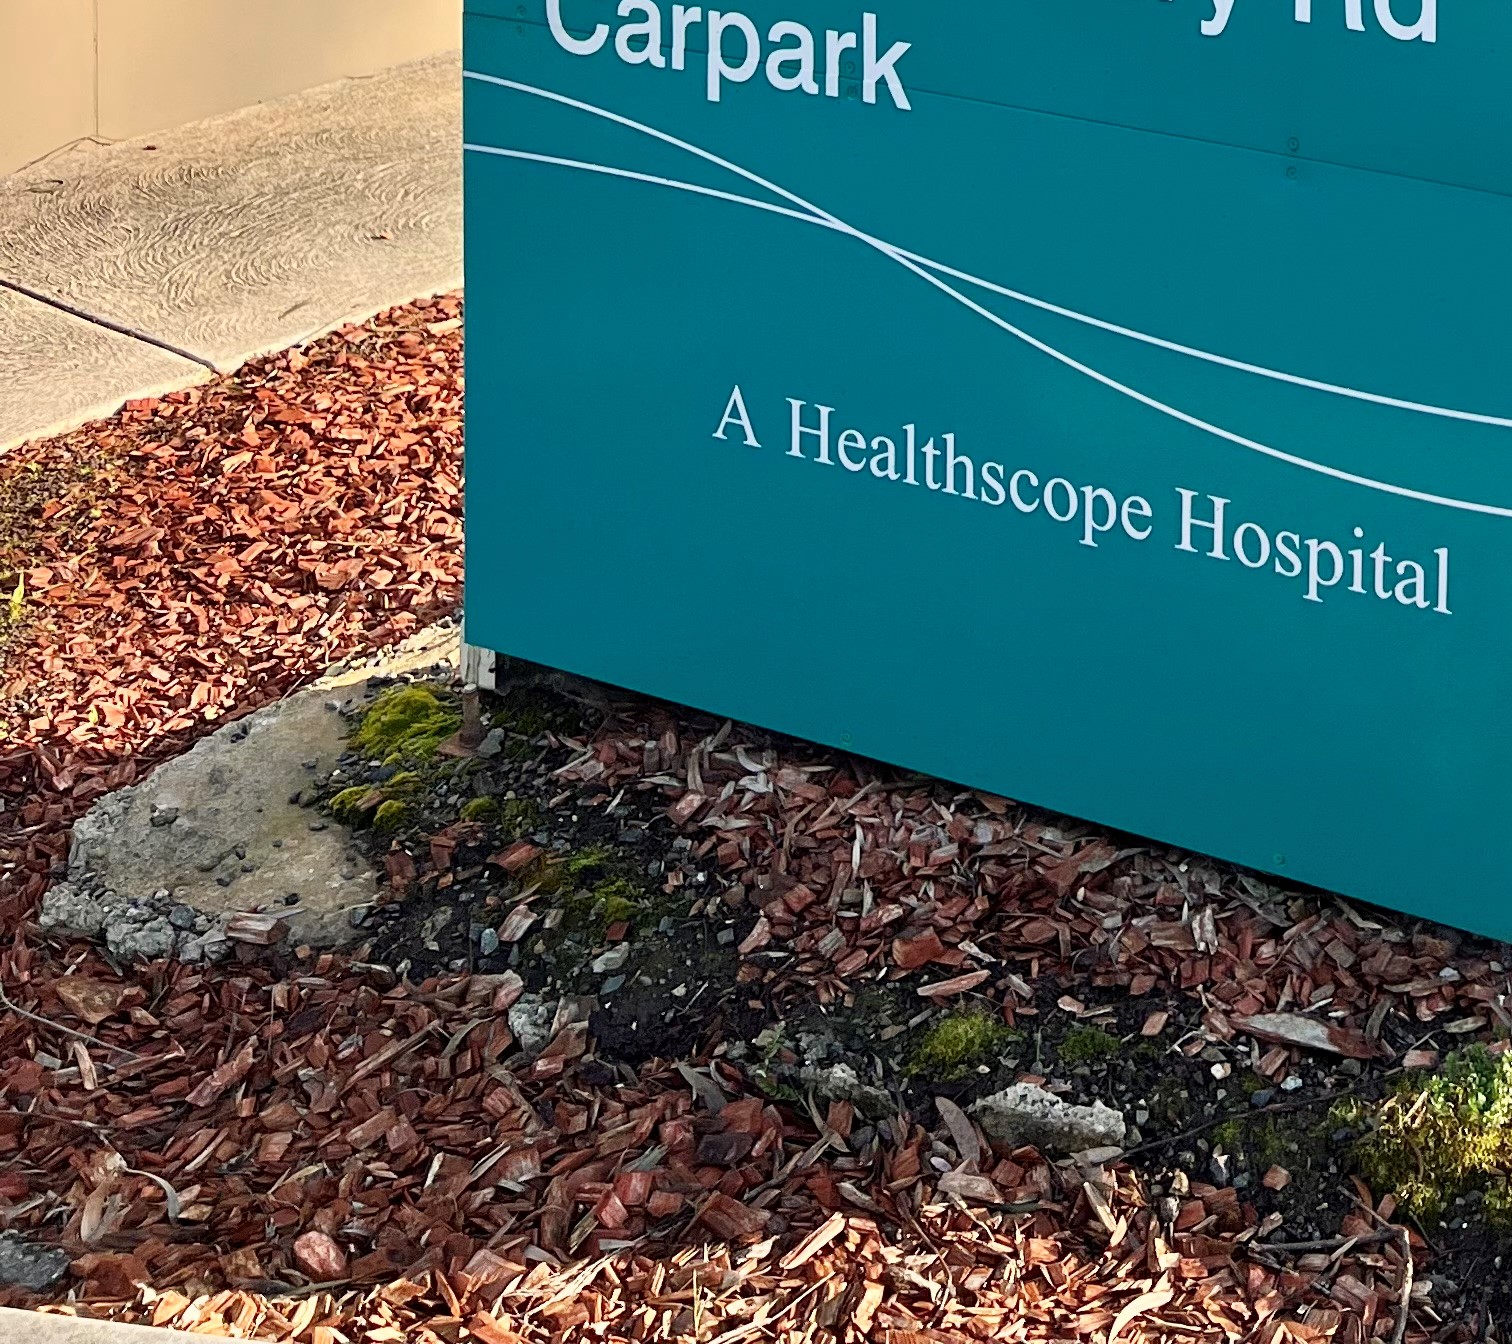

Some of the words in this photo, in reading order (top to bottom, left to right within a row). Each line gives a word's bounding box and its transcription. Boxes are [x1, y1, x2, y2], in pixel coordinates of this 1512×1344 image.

[713, 385, 760, 450] A
[787, 399, 1152, 546] Healthscope
[1176, 488, 1452, 614] Hospital
